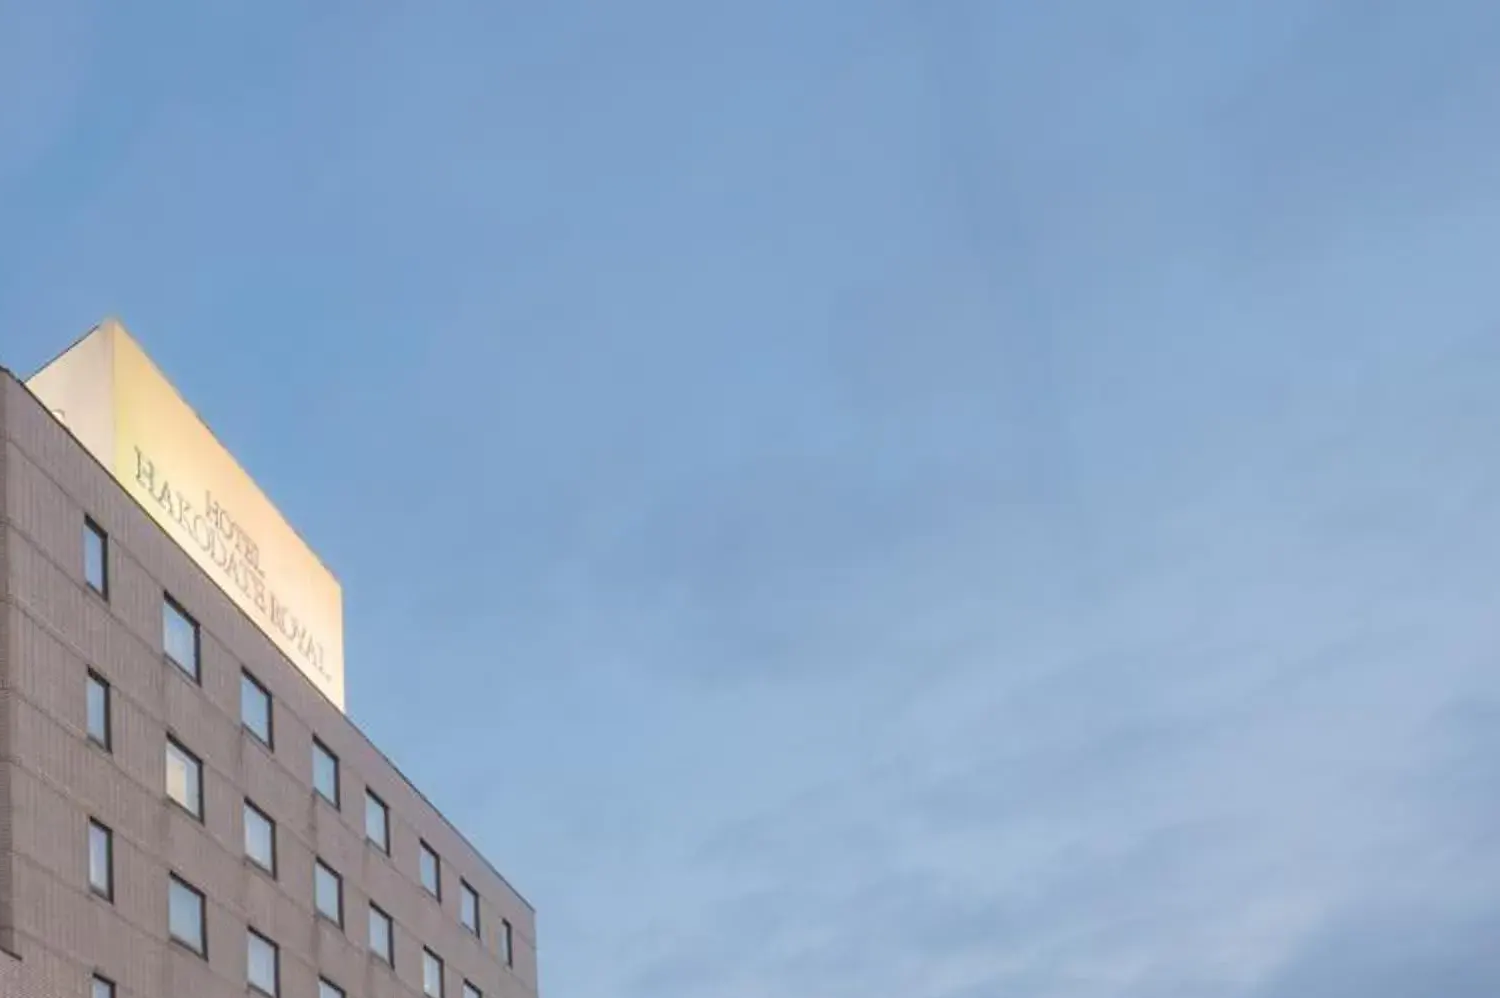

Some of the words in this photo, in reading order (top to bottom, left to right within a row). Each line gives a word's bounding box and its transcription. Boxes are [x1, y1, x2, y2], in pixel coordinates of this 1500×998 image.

[134, 445, 267, 614] HAKODATE
[269, 590, 332, 683] ROYAL
[205, 489, 265, 578] HOTEL
